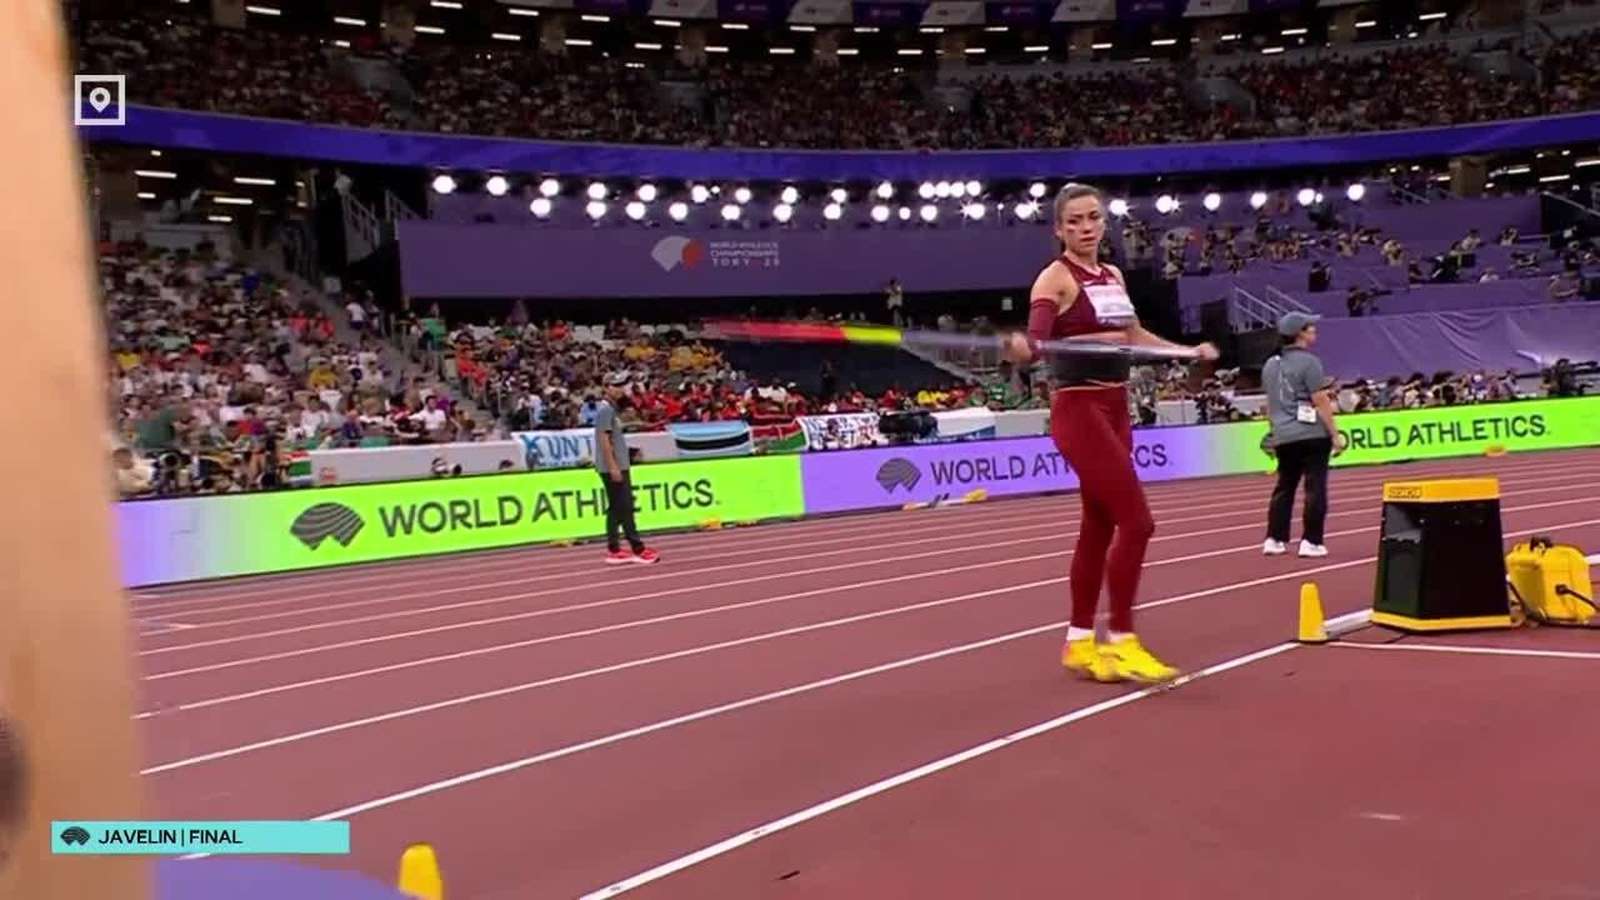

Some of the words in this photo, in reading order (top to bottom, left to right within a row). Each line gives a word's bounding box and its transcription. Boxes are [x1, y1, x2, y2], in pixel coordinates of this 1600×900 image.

[1333, 426, 1401, 456] ORLD
[1406, 414, 1546, 446] ATHLETICS
[929, 454, 1026, 485] WORLD
[379, 495, 523, 537] WORLD
